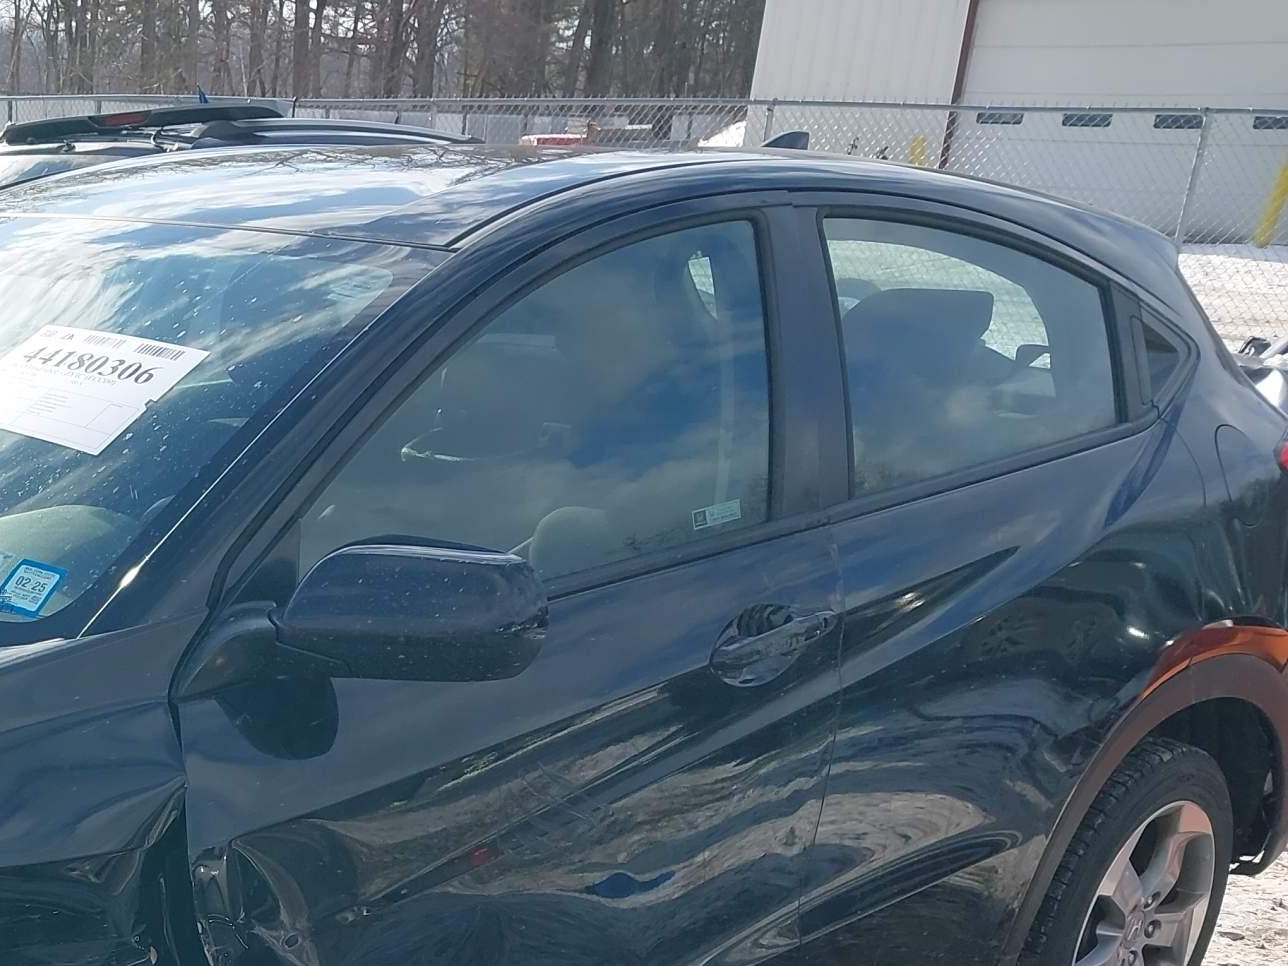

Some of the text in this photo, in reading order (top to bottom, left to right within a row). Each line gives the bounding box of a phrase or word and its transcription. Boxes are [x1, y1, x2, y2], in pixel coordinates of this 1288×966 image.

[23, 346, 162, 384] 44180306
[15, 575, 32, 589] 02
[31, 581, 49, 593] 25
